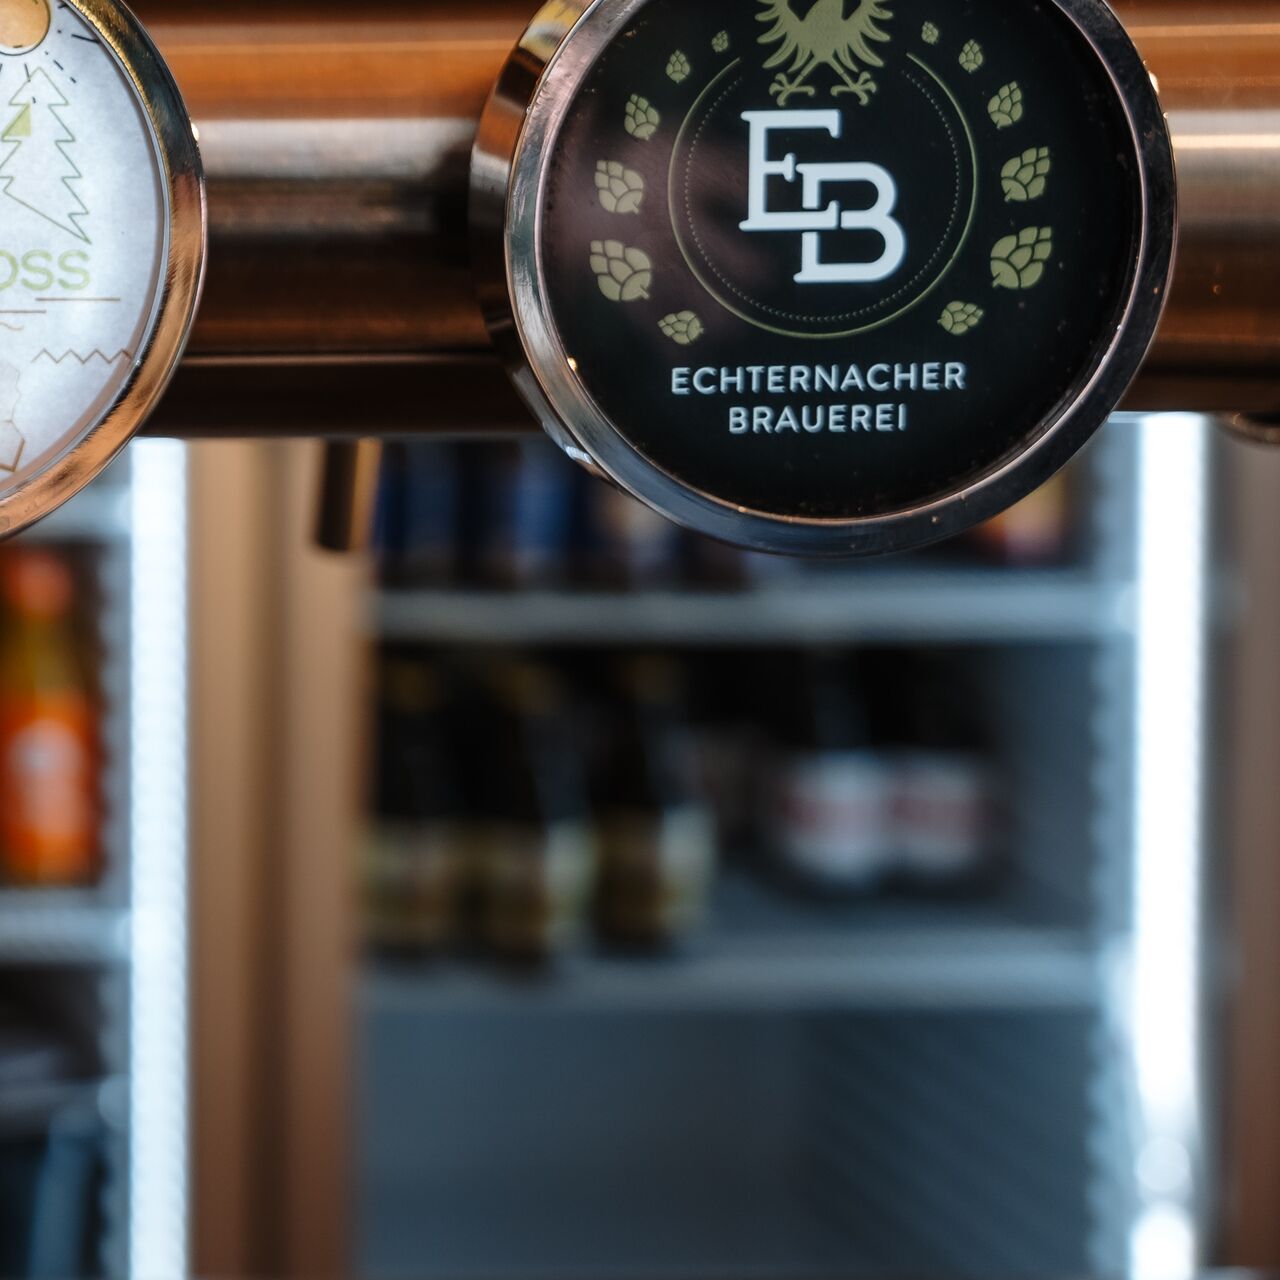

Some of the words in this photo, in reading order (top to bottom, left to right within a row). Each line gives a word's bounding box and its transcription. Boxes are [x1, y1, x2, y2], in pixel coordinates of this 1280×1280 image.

[738, 109, 907, 283] EB
[670, 361, 967, 396] ECHTERNACHER
[728, 403, 908, 434] BRAUEREI
